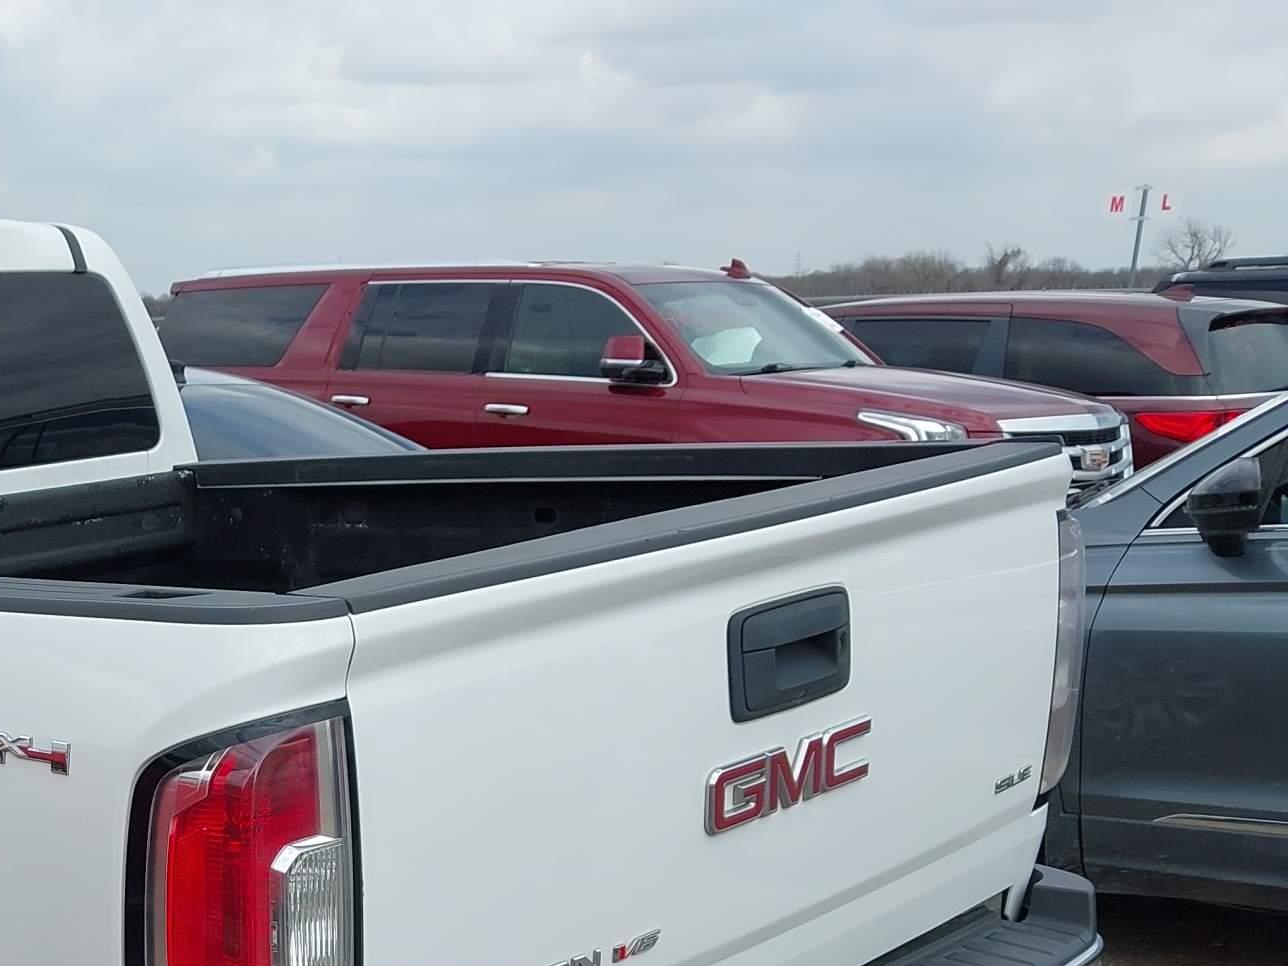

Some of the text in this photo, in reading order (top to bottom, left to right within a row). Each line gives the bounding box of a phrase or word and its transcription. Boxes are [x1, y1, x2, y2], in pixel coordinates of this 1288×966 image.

[1110, 195, 1125, 212] M
[1160, 193, 1172, 211] L
[704, 714, 872, 836] GMC
[994, 764, 1033, 795] SLE
[612, 928, 662, 964] V6
